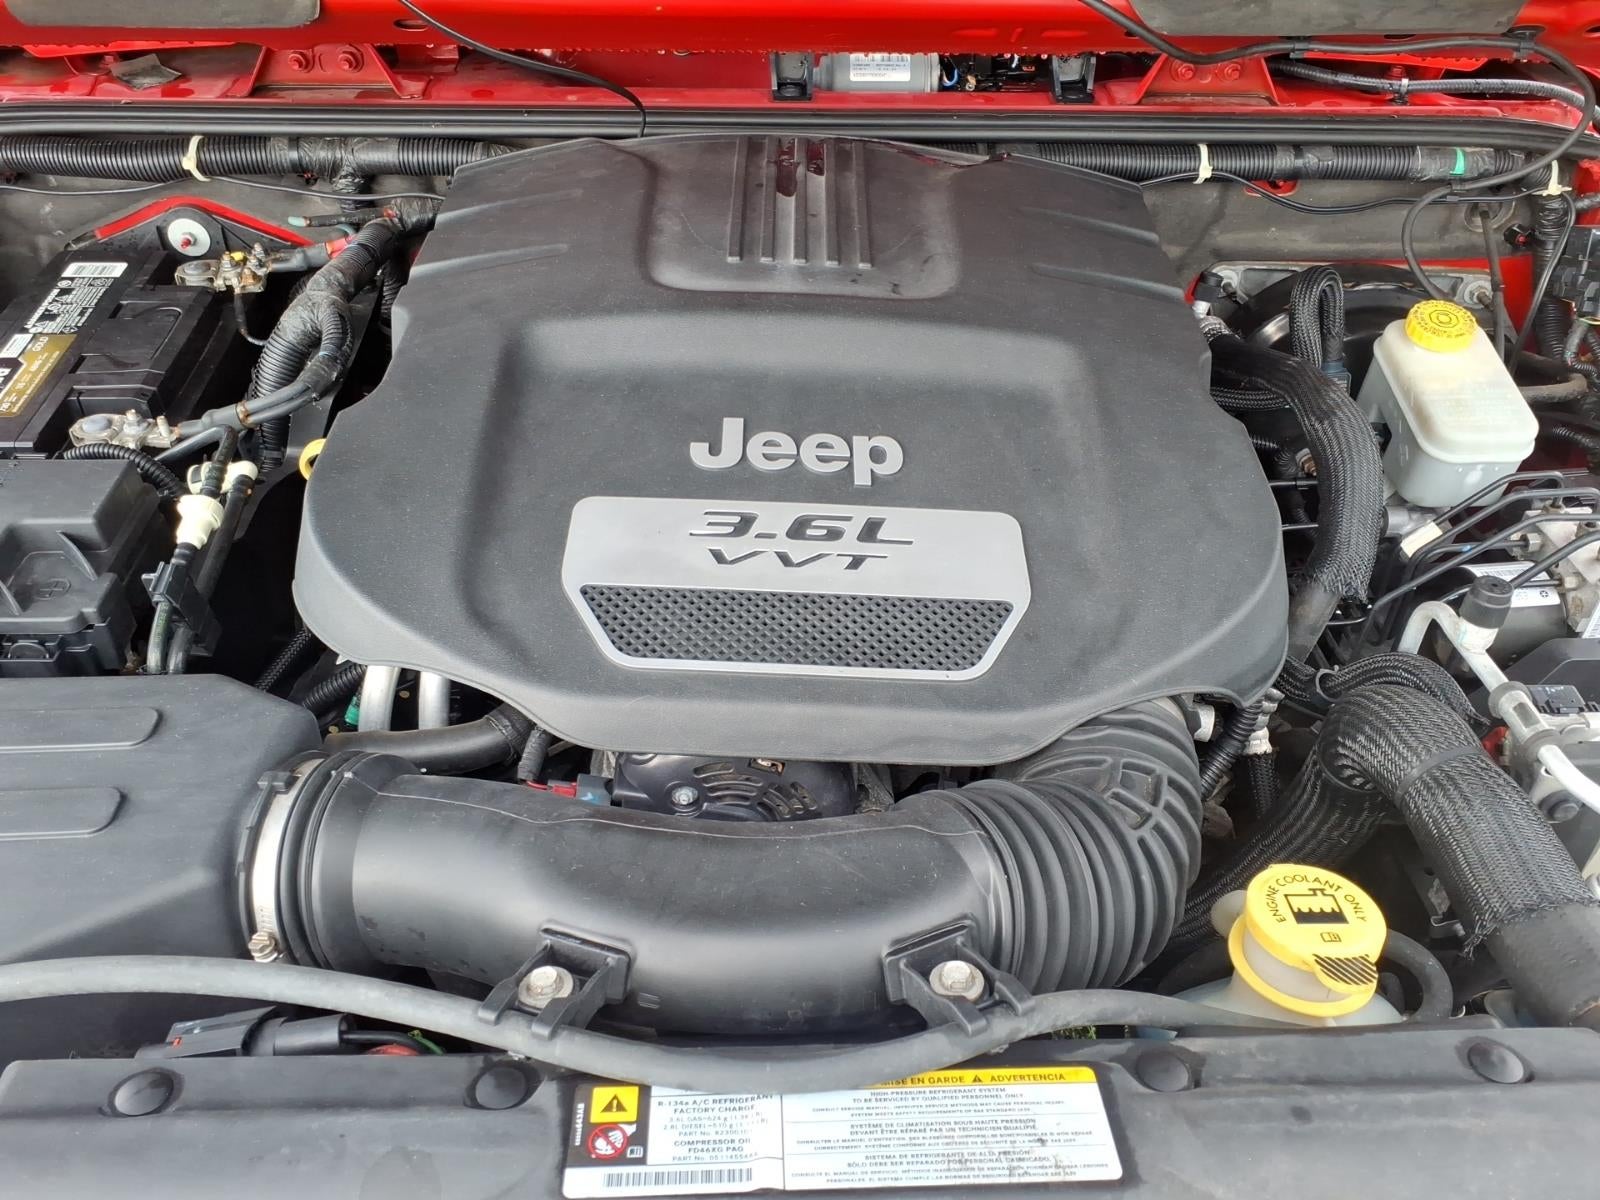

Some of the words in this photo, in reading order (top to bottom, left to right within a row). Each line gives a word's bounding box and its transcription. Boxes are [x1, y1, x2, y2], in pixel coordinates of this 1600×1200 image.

[690, 417, 904, 487] Jeep
[689, 511, 914, 546] 3.6L
[706, 547, 889, 571] VVT
[1265, 885, 1287, 923] ENGINE
[1276, 874, 1343, 893] COOLANT
[1344, 894, 1367, 922] ONLY
[910, 1077, 925, 1085] EN
[928, 1076, 965, 1084] GARDE
[990, 1073, 1067, 1082] ADVERTENCIA
[673, 1106, 716, 1114] FACTORY
[692, 1098, 710, 1106] A/C
[673, 1137, 736, 1147] COMPRESSOR
